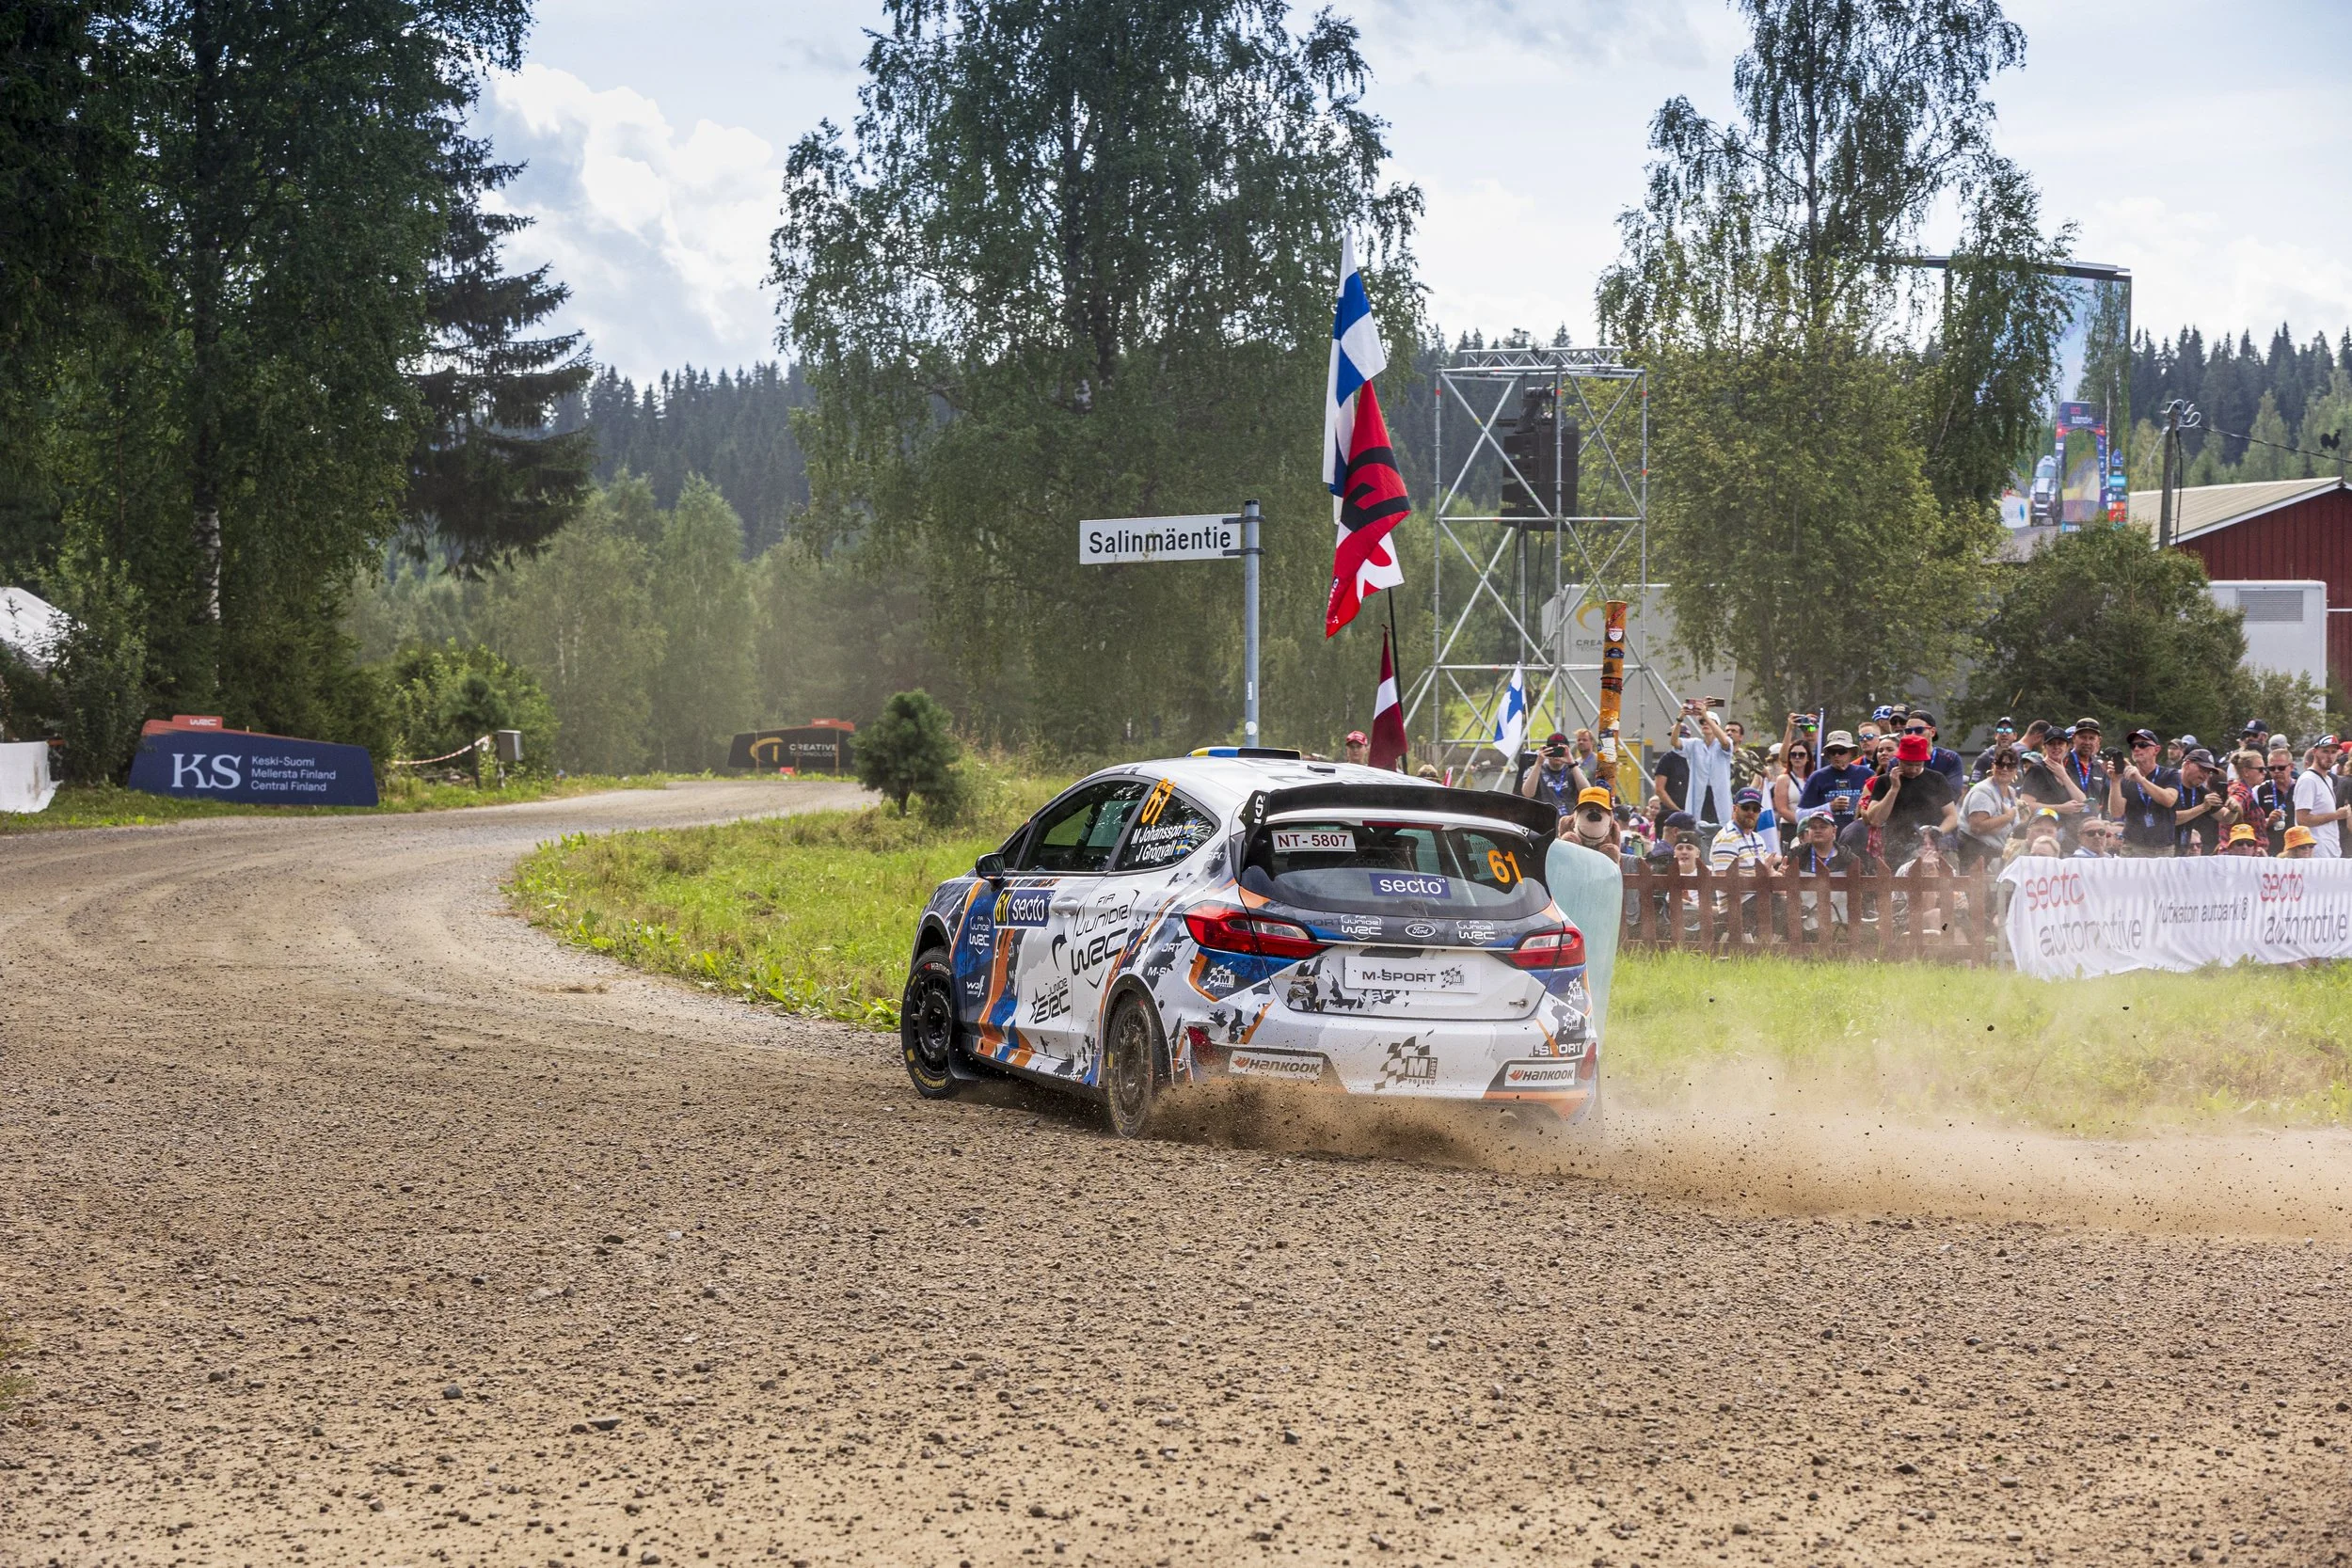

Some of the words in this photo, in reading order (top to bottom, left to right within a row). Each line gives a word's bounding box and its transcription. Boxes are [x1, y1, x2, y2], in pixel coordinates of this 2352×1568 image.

[1089, 526, 1232, 554] Salinmäentie
[189, 718, 217, 726] WRC
[251, 755, 315, 768] Keski-Suomi
[171, 753, 243, 789] KS
[251, 768, 298, 779] Mellersta
[300, 768, 337, 780] Finland
[250, 781, 288, 791] Central
[290, 782, 327, 792] Finland
[1141, 778, 1177, 825] 61
[1131, 828, 1141, 845] M
[1139, 825, 1184, 844] Johansson
[1135, 845, 1144, 863] J
[1487, 849, 1523, 885] 61
[1379, 878, 1442, 895] secto
[2260, 867, 2305, 903] secto
[995, 893, 1011, 922] 61
[1011, 895, 1045, 922] secto
[1095, 894, 1116, 908] FIA
[1075, 904, 1129, 937] JUNIOR
[2264, 904, 2347, 945] automotive
[969, 933, 990, 946] WRC
[1341, 925, 1382, 936] WRC
[1458, 930, 1496, 941] WRC
[1071, 927, 1128, 976] WRC
[1361, 970, 1437, 983] M-SPORT
